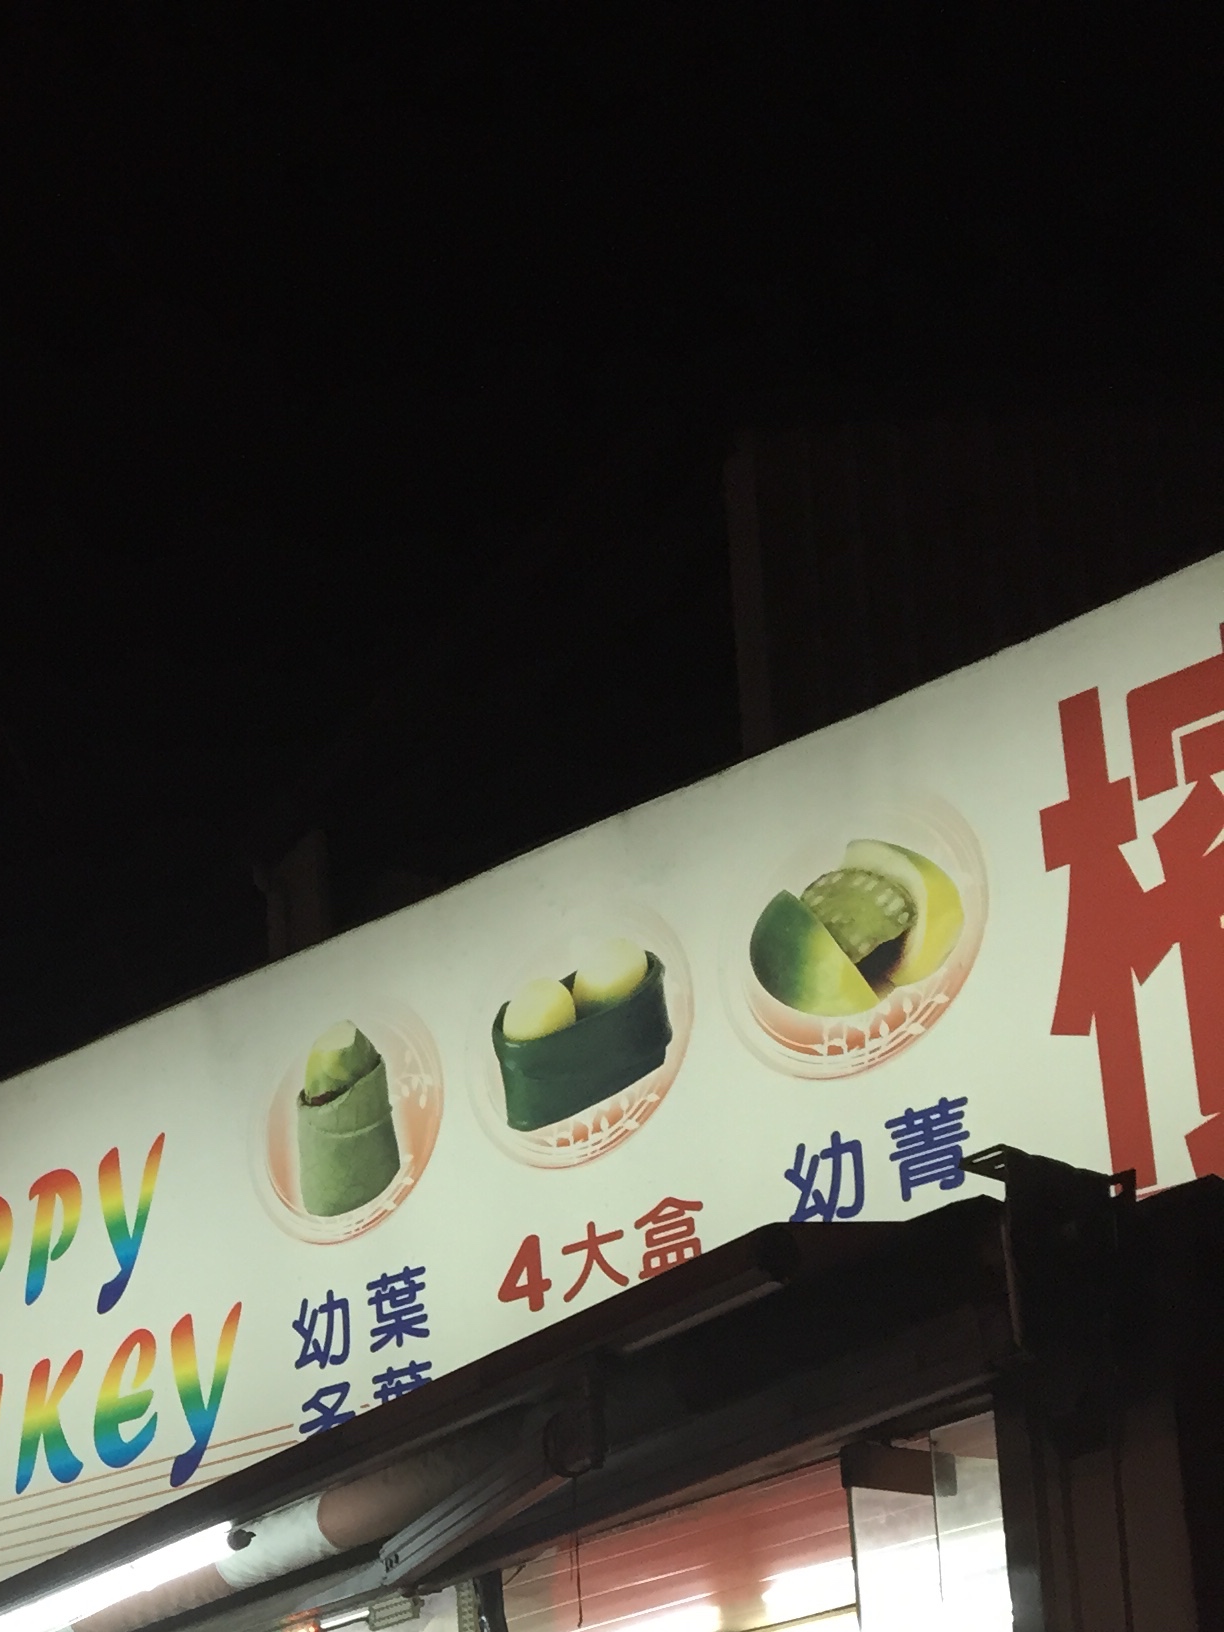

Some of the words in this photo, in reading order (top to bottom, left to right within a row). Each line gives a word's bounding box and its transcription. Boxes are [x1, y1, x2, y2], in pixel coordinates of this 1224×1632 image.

[784, 1096, 970, 1223] 幼菁
[497, 1196, 704, 1312] 4大盒
[292, 1266, 430, 1369] 幼葉
